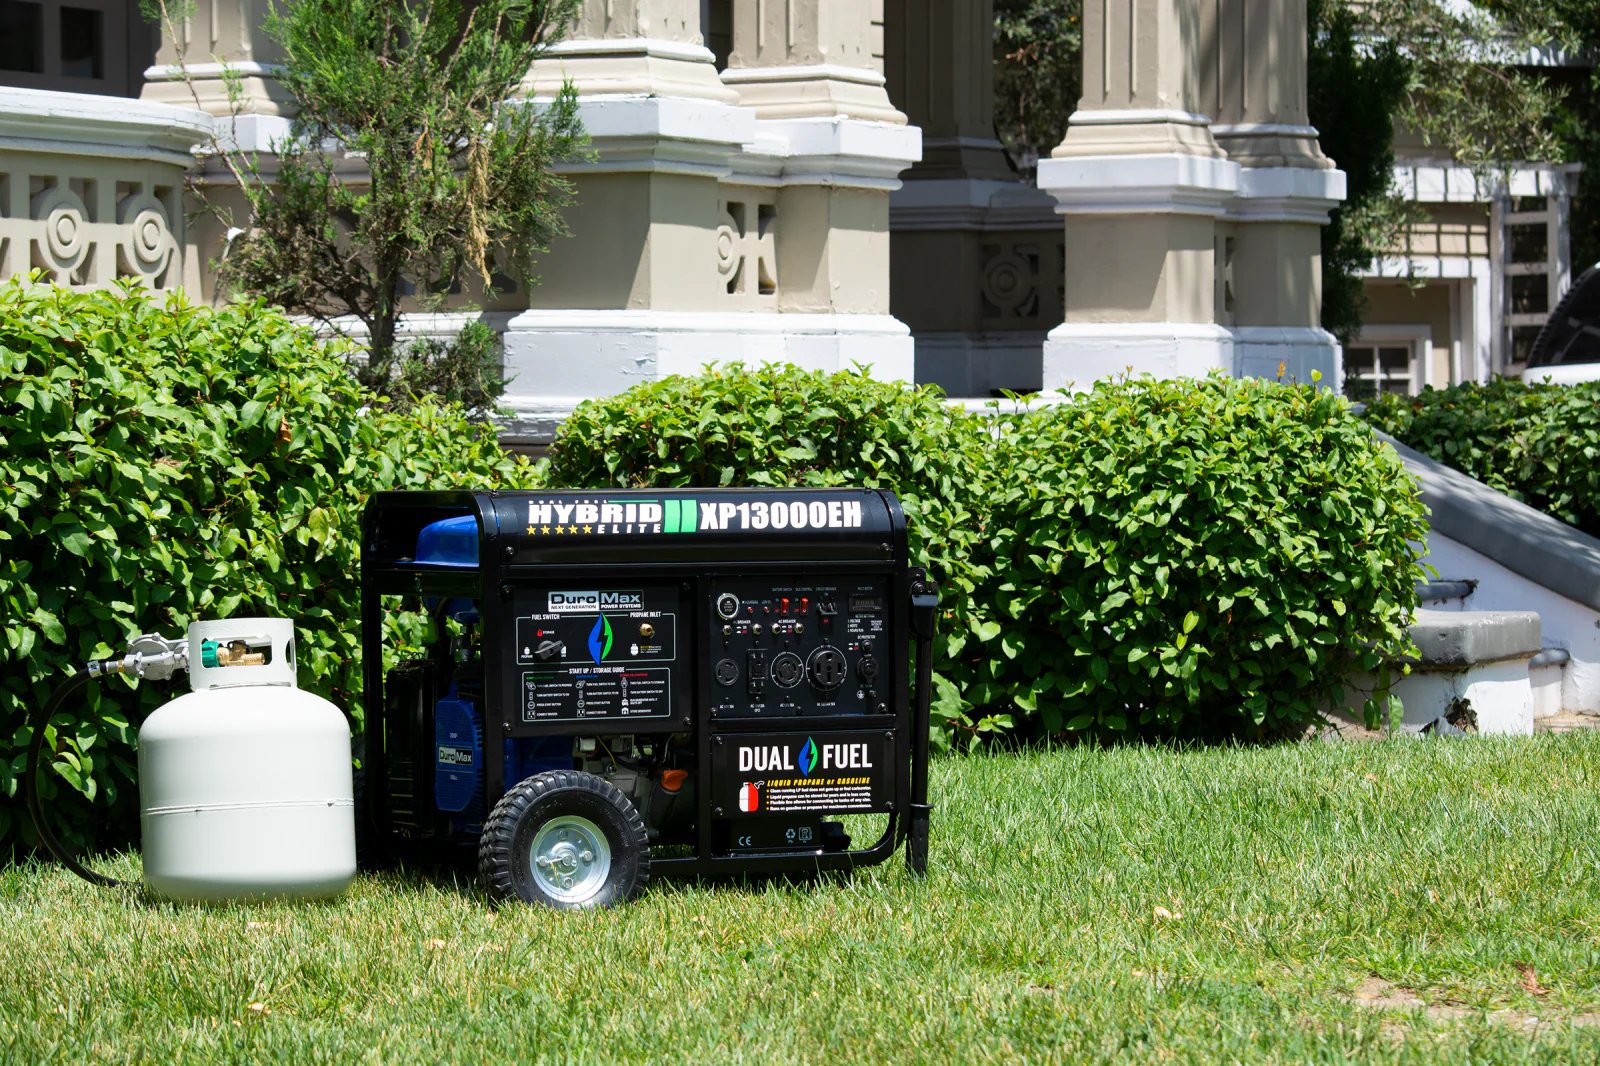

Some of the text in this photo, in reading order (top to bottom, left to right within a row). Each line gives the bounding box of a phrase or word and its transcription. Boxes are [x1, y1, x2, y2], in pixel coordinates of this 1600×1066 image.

[528, 503, 662, 524] HYBRID
[700, 501, 861, 529] XP13000EH
[597, 523, 661, 534] ELITE
[739, 744, 872, 771] DUAL FUEL
[738, 836, 751, 846] CE
